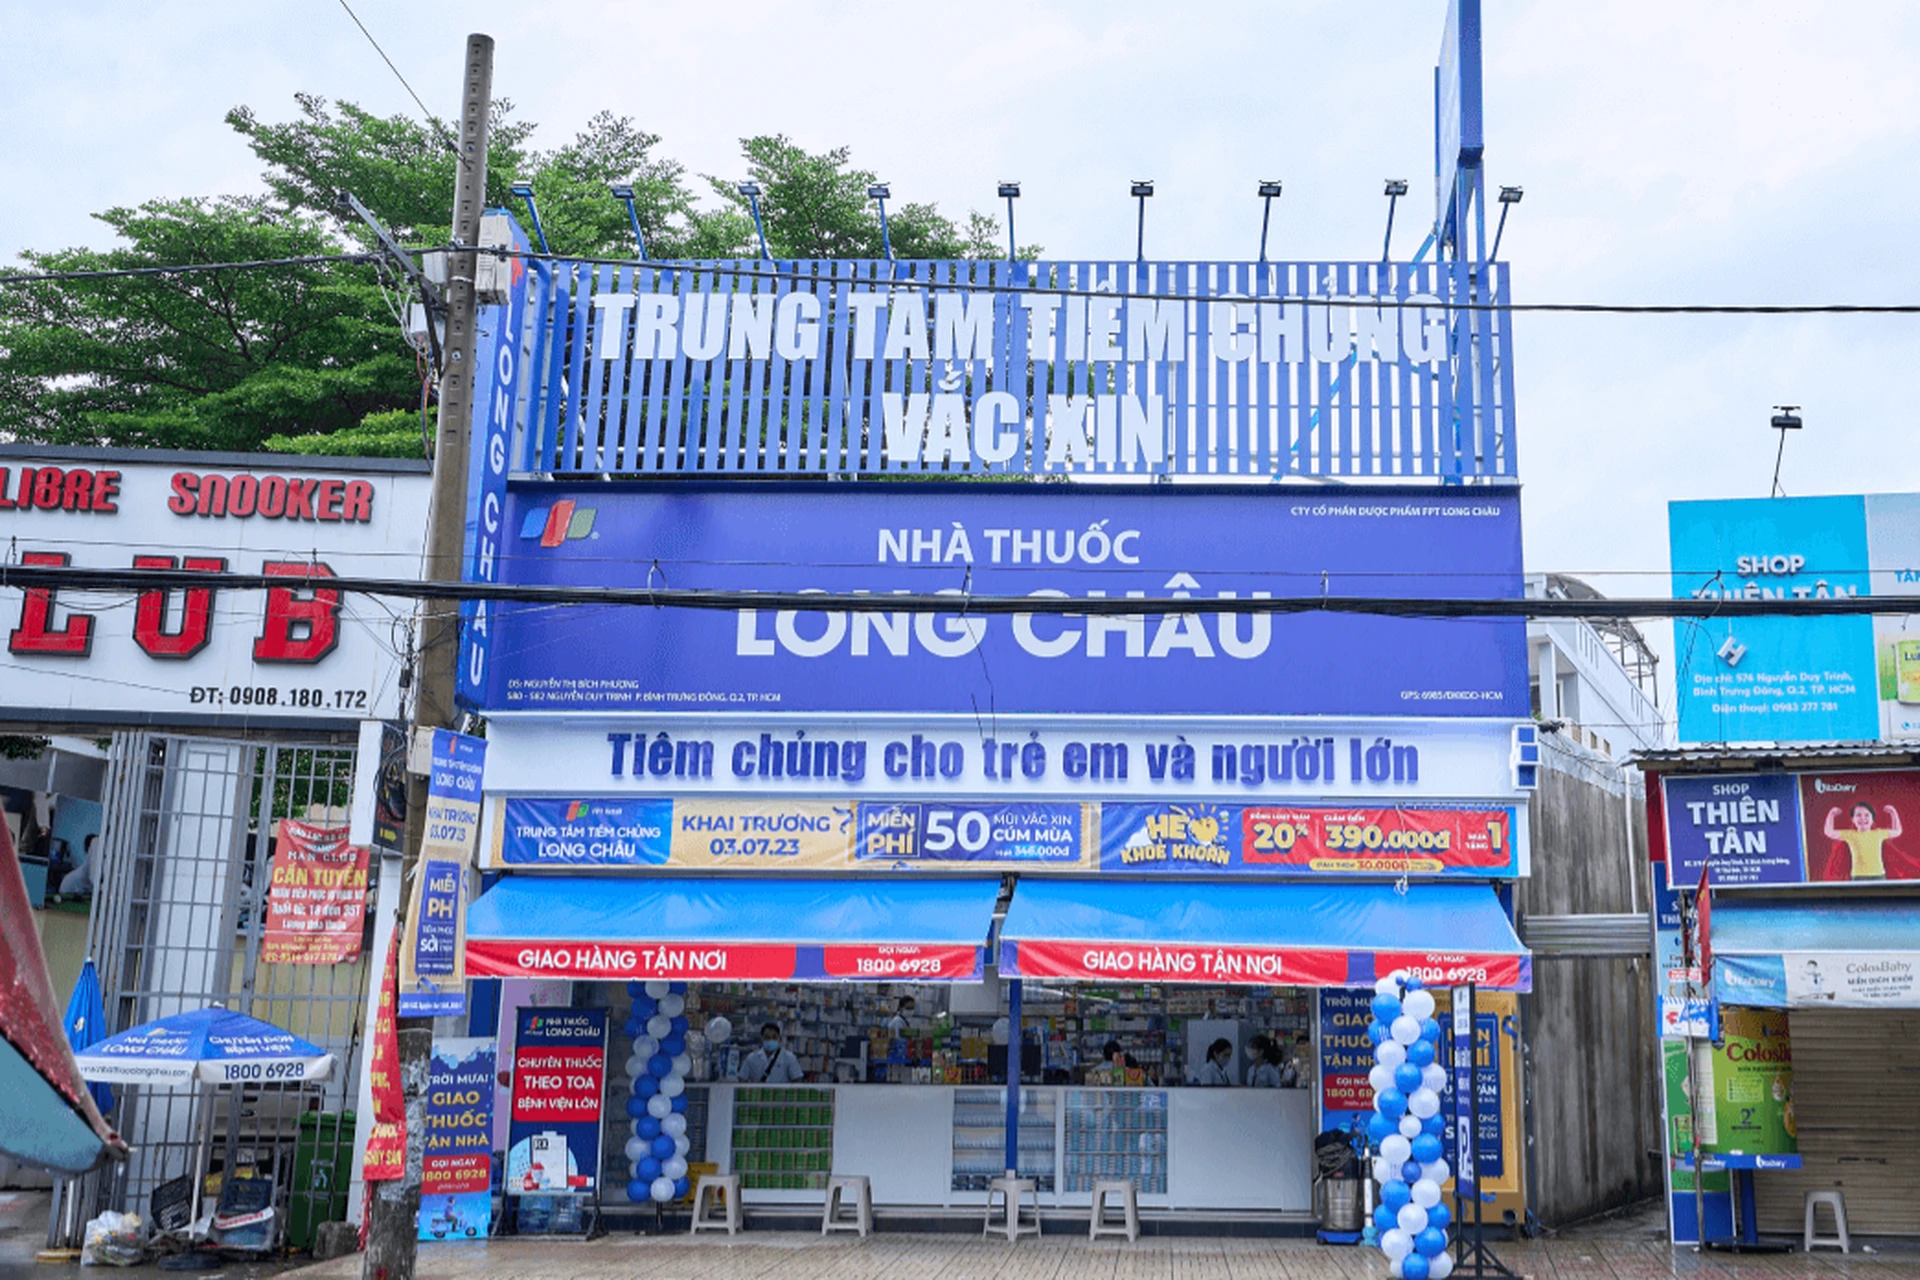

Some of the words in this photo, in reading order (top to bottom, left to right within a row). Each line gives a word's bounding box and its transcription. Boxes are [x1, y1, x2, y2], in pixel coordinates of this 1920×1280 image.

[594, 292, 821, 361] TRUNG
[847, 279, 995, 360] TÂM
[1021, 280, 1185, 361] TIÊM
[1212, 275, 1448, 363] CHỦNG
[491, 302, 514, 475] LONG
[882, 370, 1020, 463] VẮC
[1046, 394, 1163, 463] XIN
[168, 472, 373, 522] SNOOKER
[1290, 506, 1310, 516] CTY
[1422, 506, 1440, 516] FPT
[1442, 507, 1470, 516] LONG
[878, 521, 974, 563] NHÀ
[983, 519, 1141, 564] THUỐC
[1736, 554, 1805, 576] SHOP
[736, 588, 987, 658] LONG
[1012, 571, 1272, 660] CHÂU
[1756, 671, 1798, 684] Nguyễn
[1800, 672, 1821, 684] Duy
[189, 687, 223, 705] ĐT:
[230, 687, 367, 709] 0908.180.172
[1828, 685, 1856, 695] HCM
[607, 731, 714, 777] Tiêm
[731, 730, 868, 782] chủng
[883, 735, 965, 779] cho
[982, 730, 1046, 779] trẻ
[1062, 742, 1129, 780] em
[1145, 735, 1196, 780] và
[1212, 736, 1335, 785] người
[1349, 737, 1419, 782] lớn
[1712, 783, 1750, 796] SHOP
[867, 805, 915, 828] MIỄN
[993, 813, 1018, 825] MŨI
[1051, 814, 1072, 825] XIN
[1686, 796, 1780, 825] THIÊN
[516, 827, 557, 838] TRUNG
[560, 825, 585, 838] TÂM
[588, 825, 615, 838] TIÊM
[617, 824, 661, 838] CHỦNG
[682, 816, 734, 831] KHAI
[740, 813, 831, 832] TRƯƠNG
[924, 811, 991, 852] 50
[867, 828, 916, 855] PHÍ
[993, 827, 1031, 842] CÚM
[1034, 826, 1073, 842] MÙA
[1704, 826, 1767, 855] TÂN
[538, 843, 585, 857] LONG
[589, 840, 636, 857] CHÂU
[709, 838, 800, 856] 03.07.23
[517, 949, 571, 969] GIAO
[575, 945, 636, 970] HÀNG
[642, 945, 684, 974] TẬN
[689, 948, 727, 970] NƠI
[857, 958, 896, 973] 1800
[899, 958, 941, 973] 6928
[1083, 951, 1134, 971] GIAO
[1138, 948, 1196, 973] HÀNG
[1200, 949, 1241, 980] TẬN
[1246, 953, 1282, 975] NƠI
[1846, 961, 1912, 974] ColosBaby
[1406, 966, 1443, 981] 1800
[1447, 967, 1487, 981] 6928
[1325, 994, 1351, 1007] TRỜI
[546, 1027, 573, 1037] LONG
[574, 1026, 600, 1037] CHÂU
[517, 1055, 561, 1069] CHUYÊN
[564, 1053, 602, 1069] THUỐC
[1323, 1053, 1353, 1069] TẬN
[224, 1064, 262, 1081] 1800
[265, 1062, 305, 1079] 6928
[524, 1075, 562, 1090] THEO
[566, 1075, 595, 1090] TOA
[432, 1090, 481, 1106] GIAO
[1326, 1088, 1355, 1098] 1800
[518, 1097, 547, 1112] BỆNH
[549, 1097, 573, 1112] VIỆN
[455, 1130, 490, 1148] NHÀ
